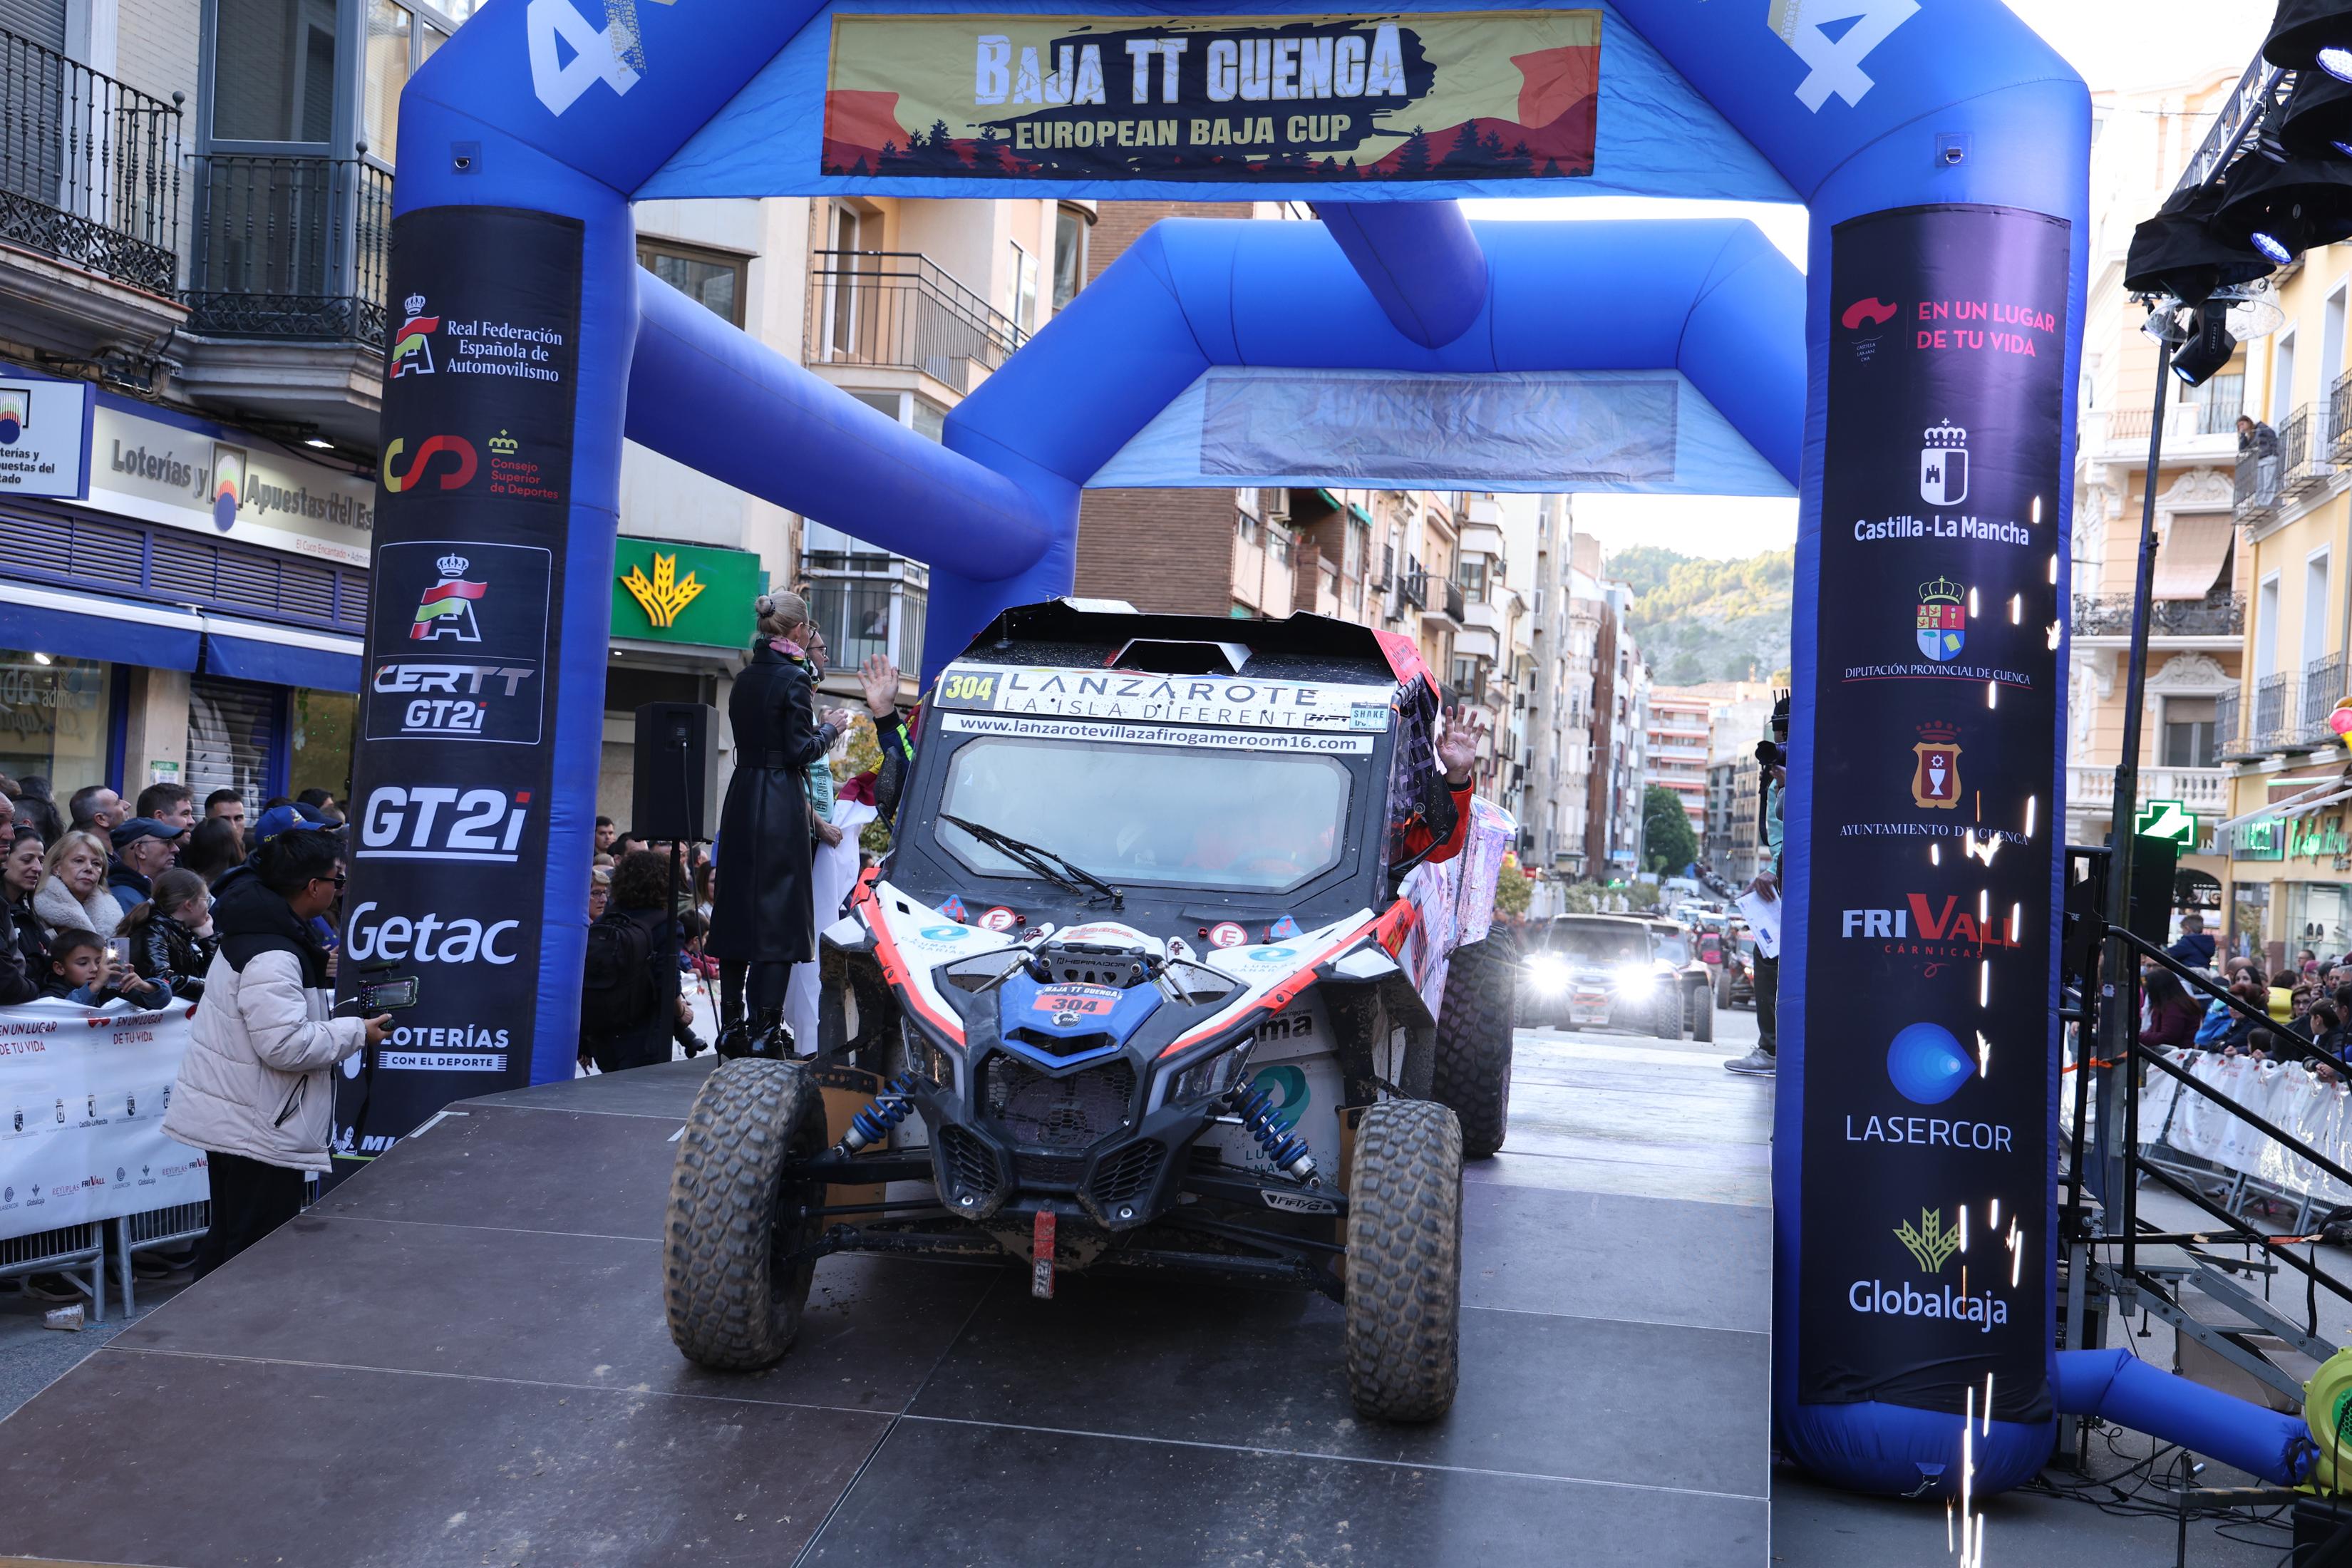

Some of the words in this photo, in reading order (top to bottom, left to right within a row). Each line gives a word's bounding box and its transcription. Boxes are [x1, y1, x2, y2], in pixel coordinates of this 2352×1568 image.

[975, 35, 1106, 105] BAJA
[1125, 37, 1188, 104] TT
[1207, 21, 1407, 102] CUENCA
[1016, 119, 1184, 150] EUROPEAN
[1190, 117, 1274, 145] BAJA
[1287, 115, 1351, 143] CUP
[1919, 301, 1947, 320] EN
[1955, 301, 1987, 321] UN
[1993, 303, 2055, 334] LUGAR
[448, 321, 477, 336] Real
[483, 321, 562, 345] Federación
[459, 339, 526, 359] Española
[531, 346, 549, 361] de
[1917, 331, 1946, 349] DE
[1954, 330, 1984, 349] TU
[1989, 332, 2036, 357] VIDA
[446, 358, 559, 382] Automovilismo
[33, 452, 39, 462] y
[491, 458, 537, 472] Consejo
[38, 463, 55, 473] del
[112, 439, 191, 488] Loterías
[195, 467, 209, 498] y
[491, 470, 540, 485] Superior
[490, 483, 505, 493] de
[508, 485, 559, 499] Deportes
[245, 475, 325, 515] Apuestas
[325, 492, 353, 525] del
[353, 502, 373, 531] Es
[1961, 516, 2029, 545] Mancha
[1845, 663, 1907, 679] DIPUTACIÓN
[1911, 664, 1974, 677] PROVINCIAL
[1976, 667, 1991, 679] DE
[1993, 669, 2031, 685] CUENCA
[946, 676, 994, 701] 304
[1009, 674, 1319, 706] LANZAROTE
[405, 699, 488, 728] GT2i
[1004, 697, 1037, 712] LA
[1057, 699, 1123, 717] ISLA
[1143, 704, 1317, 727] DIFERENTE
[1354, 710, 1384, 718] SHAKE
[960, 719, 1357, 750] www.lanzarotevillazafirogameroom16.com
[362, 786, 531, 851] GT2i
[1840, 823, 1949, 836] AYUNTAMIENTO
[989, 914, 1006, 927] E
[347, 901, 520, 964] Getac
[1220, 929, 1237, 943] E
[1884, 943, 1982, 959] CÁRNICAS
[1084, 988, 1118, 998] CUENCA
[1052, 999, 1098, 1012] 304
[11, 1023, 25, 1036] UN
[26, 1021, 57, 1034] LUGAR
[115, 1016, 128, 1026] EN
[128, 1016, 140, 1026] UN
[139, 1013, 163, 1025] LUGAR
[114, 1033, 123, 1044] DE
[125, 1031, 135, 1043] TU
[136, 1031, 153, 1042] VIDA
[0, 1043, 11, 1055] DE
[11, 1042, 24, 1053] TU
[25, 1041, 46, 1052] VIDA
[392, 1056, 416, 1066] CON
[421, 1057, 433, 1066] EL
[438, 1058, 492, 1067] DEPORTE
[1847, 1115, 2012, 1152] LASERCOR
[189, 1157, 208, 1169] FRIVAL
[81, 1175, 105, 1187] FRIVALL
[1849, 1279, 2007, 1333] Globalcaja
